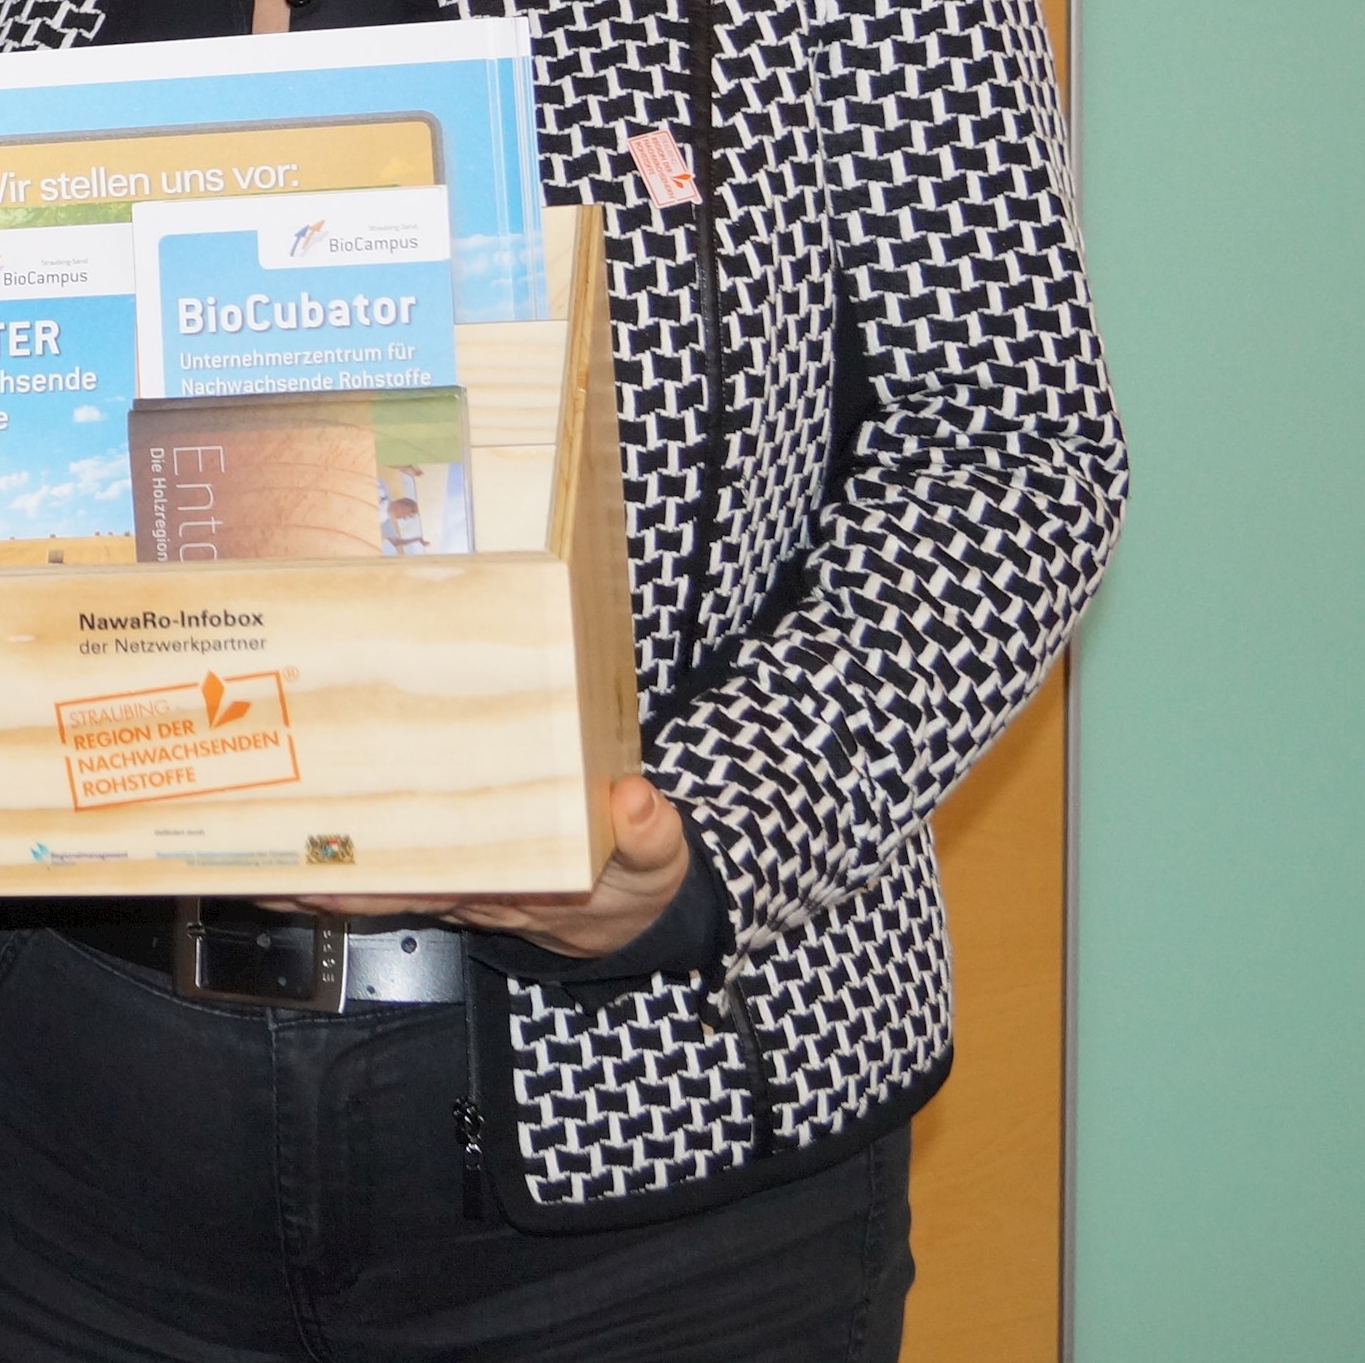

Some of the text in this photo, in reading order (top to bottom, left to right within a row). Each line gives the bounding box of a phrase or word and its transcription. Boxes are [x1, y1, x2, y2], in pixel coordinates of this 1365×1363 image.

[41, 166, 150, 201] stellen
[161, 166, 224, 193] uns
[232, 162, 300, 189] vor:
[329, 236, 418, 253] BioCampus
[4, 271, 88, 287] BioCampus
[178, 291, 417, 335] BioCubator
[180, 342, 416, 370] Unternehmerzentrum für
[181, 368, 431, 396] Nachwachsende Rohstoffe
[150, 447, 170, 562] Die Holzregion
[79, 610, 265, 631] NawaRo-Infobox
[79, 635, 267, 656] der Netzwerkpartner
[69, 699, 170, 729] STRAUBING
[74, 719, 195, 751] REGION DER
[77, 730, 281, 774] NACHWACHSENDEN
[82, 767, 197, 798] ROHSTOFFE
